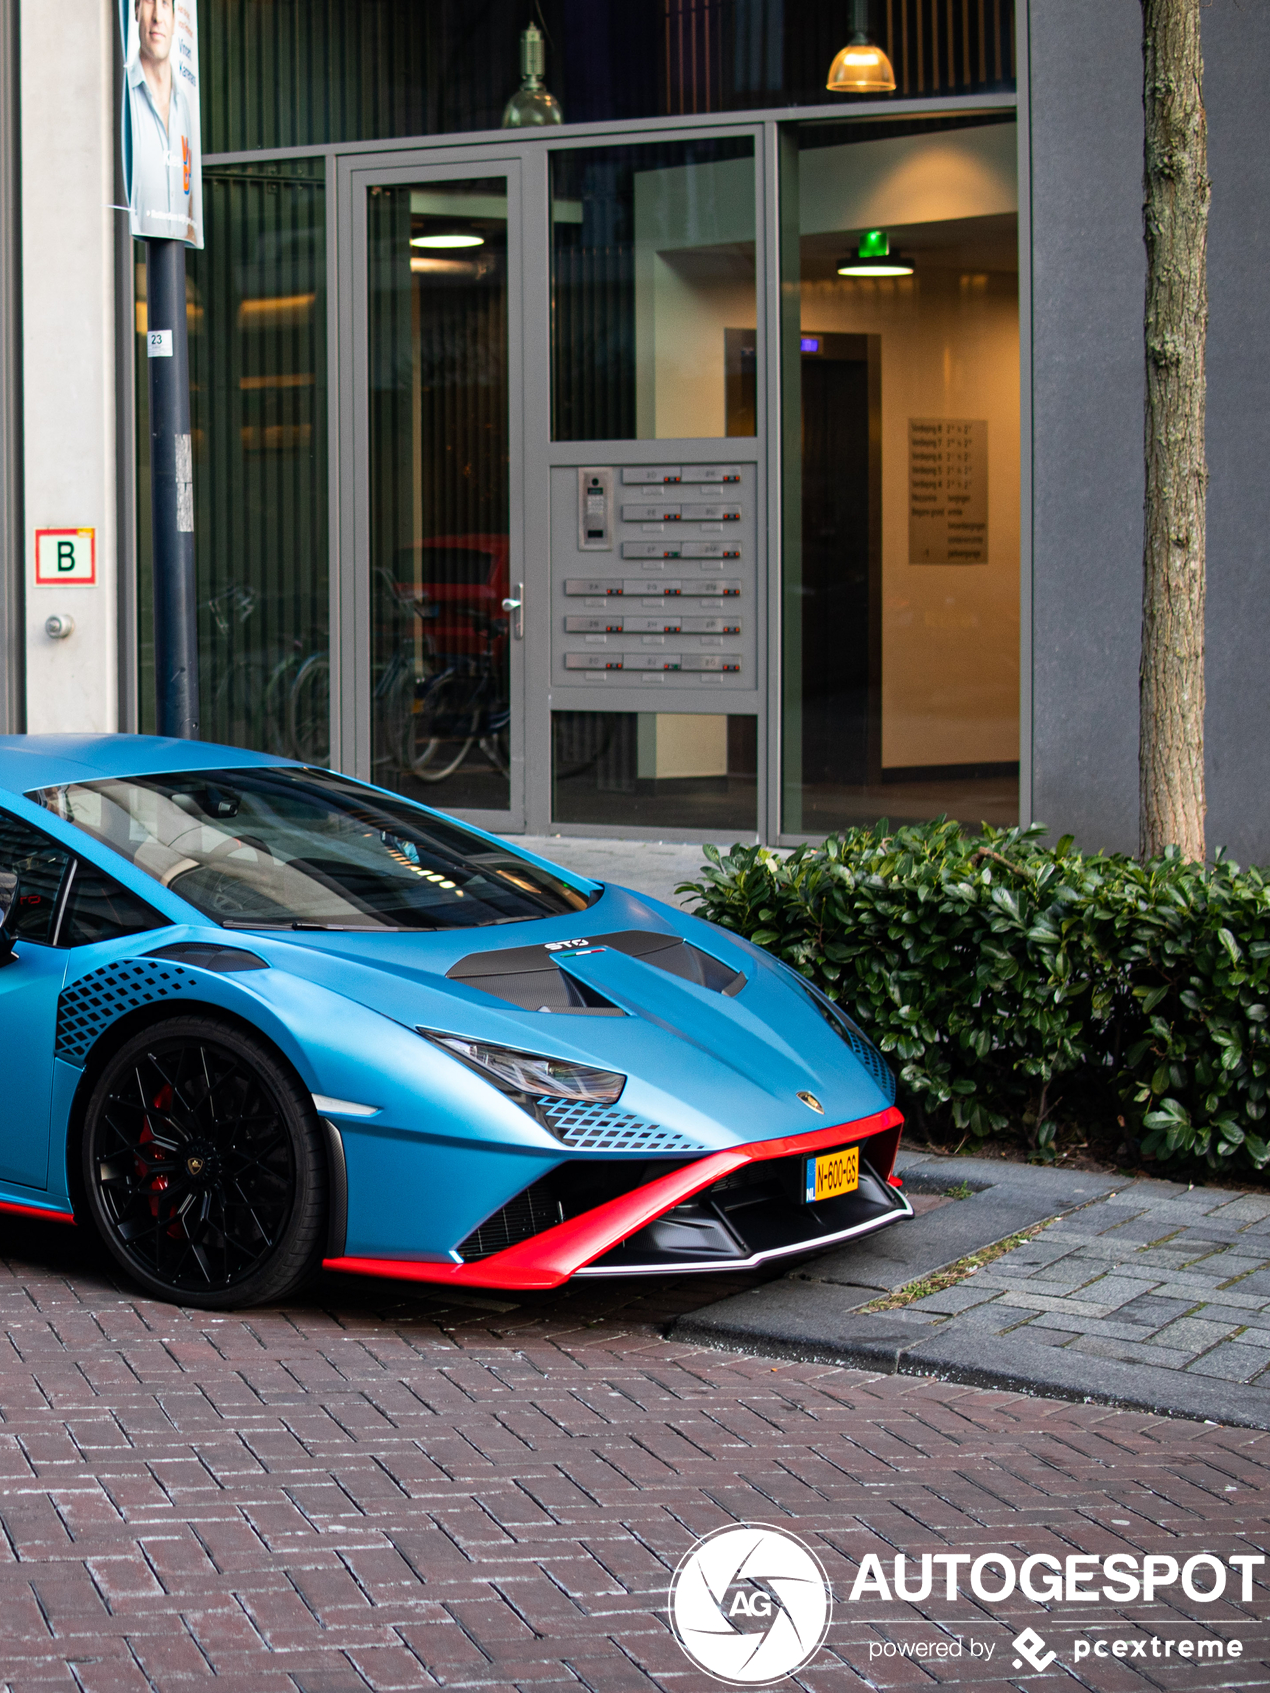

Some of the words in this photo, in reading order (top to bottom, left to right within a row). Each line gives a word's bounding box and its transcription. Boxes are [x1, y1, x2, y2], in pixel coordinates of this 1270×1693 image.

[151, 334, 163, 345] 23
[57, 541, 76, 572] B
[544, 938, 589, 951] STO
[817, 1154, 856, 1193] N-600-GS
[806, 1187, 816, 1202] NL
